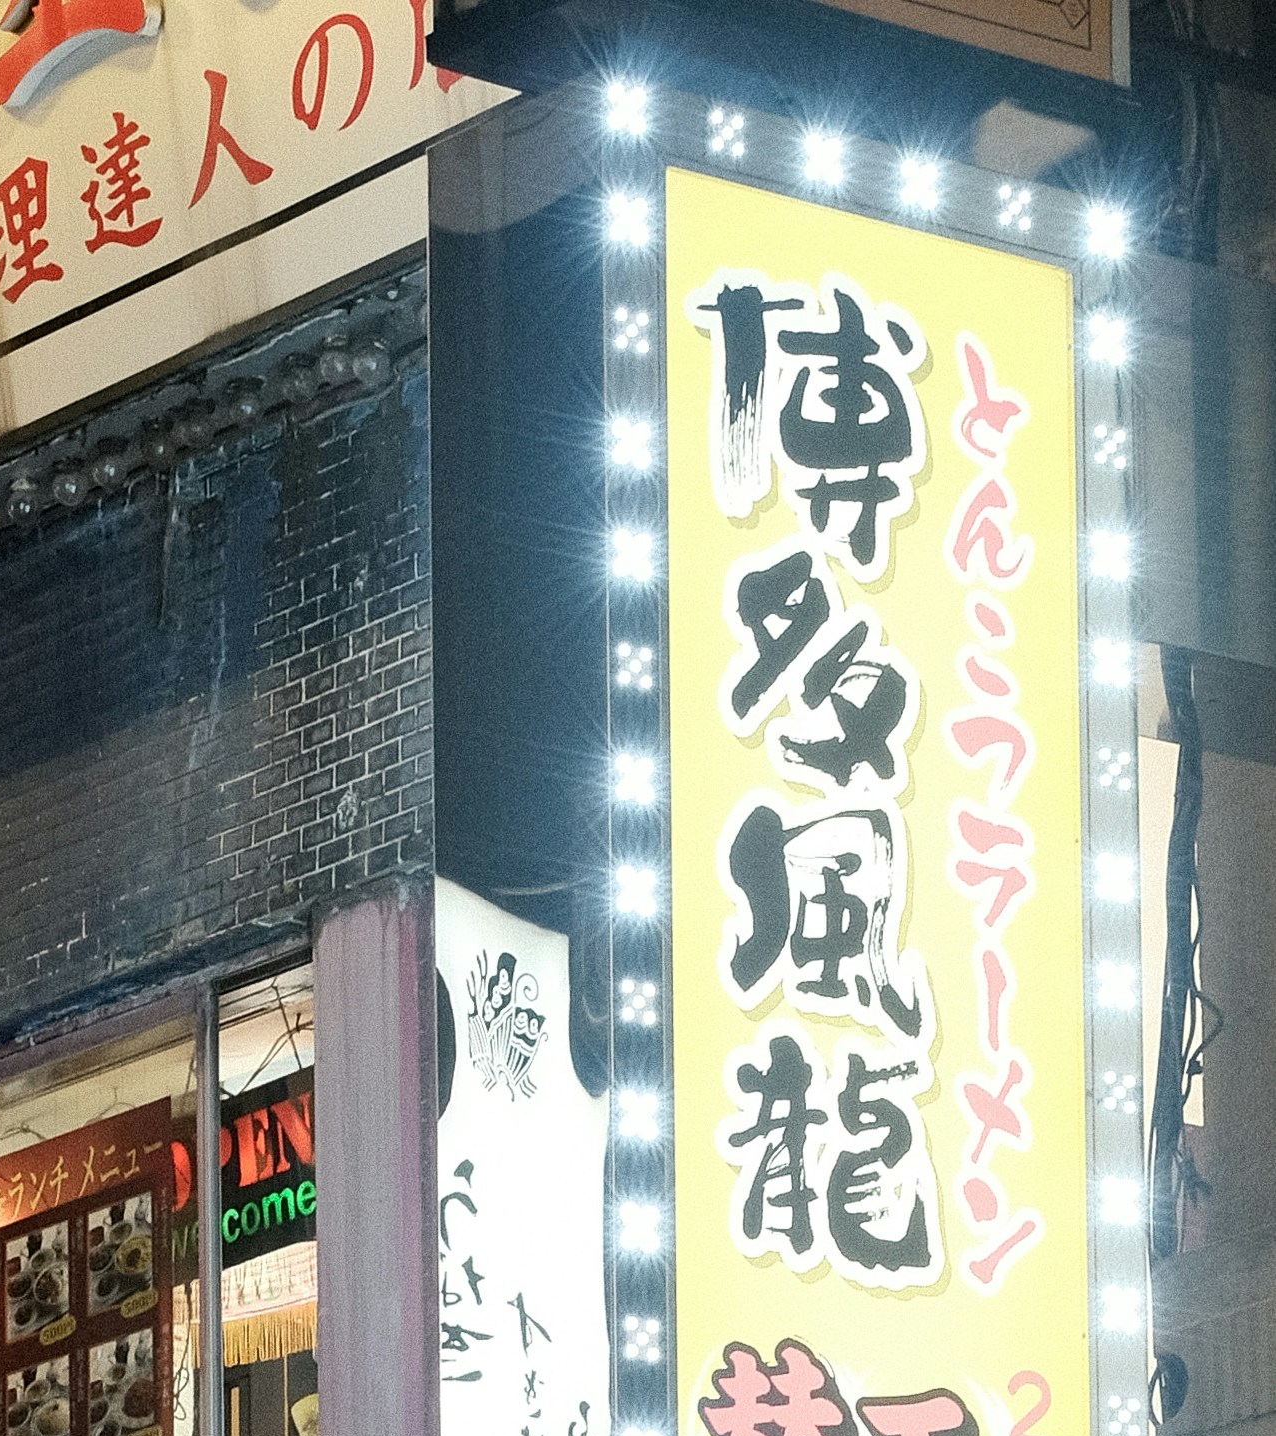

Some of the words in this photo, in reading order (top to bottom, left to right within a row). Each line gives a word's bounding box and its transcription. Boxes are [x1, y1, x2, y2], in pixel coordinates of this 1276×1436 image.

[8, 1155, 70, 1219] ランチ
[78, 1140, 164, 1197] メニュー
[697, 285, 931, 1270] 博多風龍
[951, 341, 1035, 1283] とんこつラーメン
